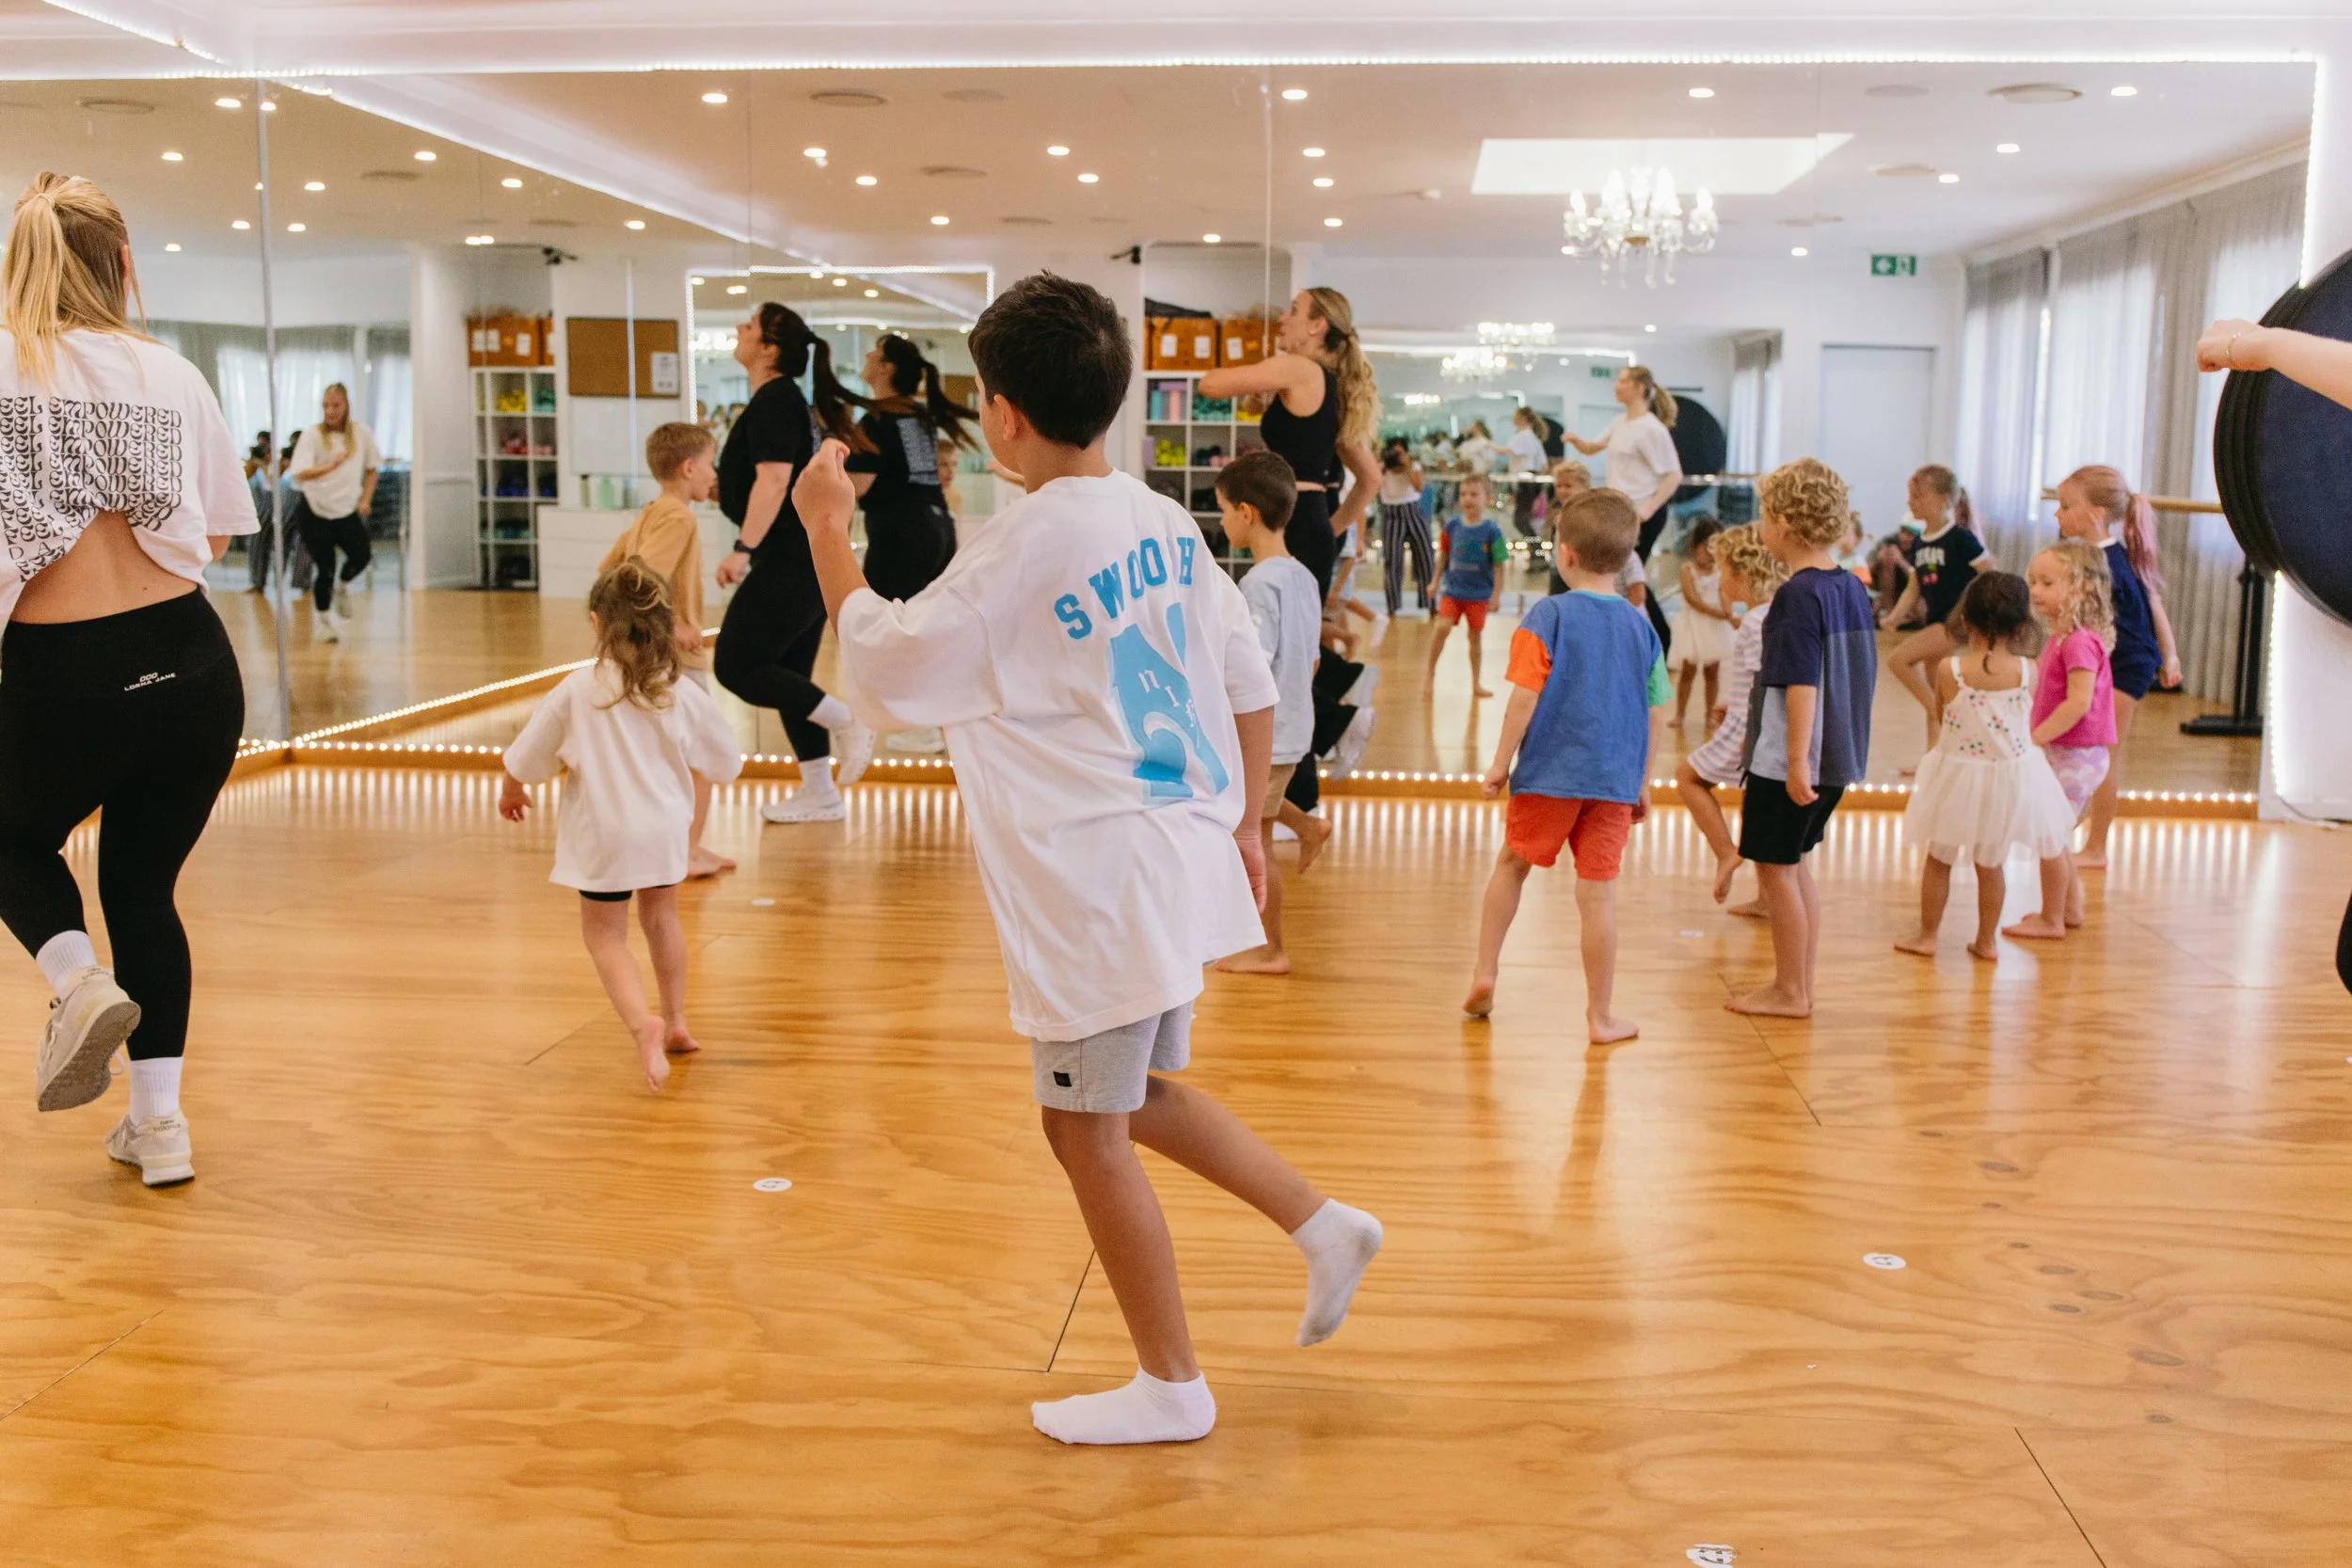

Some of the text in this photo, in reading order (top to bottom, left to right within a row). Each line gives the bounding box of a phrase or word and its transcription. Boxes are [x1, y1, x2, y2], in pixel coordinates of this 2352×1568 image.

[49, 396, 182, 428] EMPOWERED
[49, 416, 182, 445] EMPOWERED
[50, 435, 182, 461] EMPOWERED
[0, 452, 182, 477] EEL EMPOWERED
[1054, 536, 1196, 640] SWOOH
[123, 673, 177, 691] LORNA JANE
